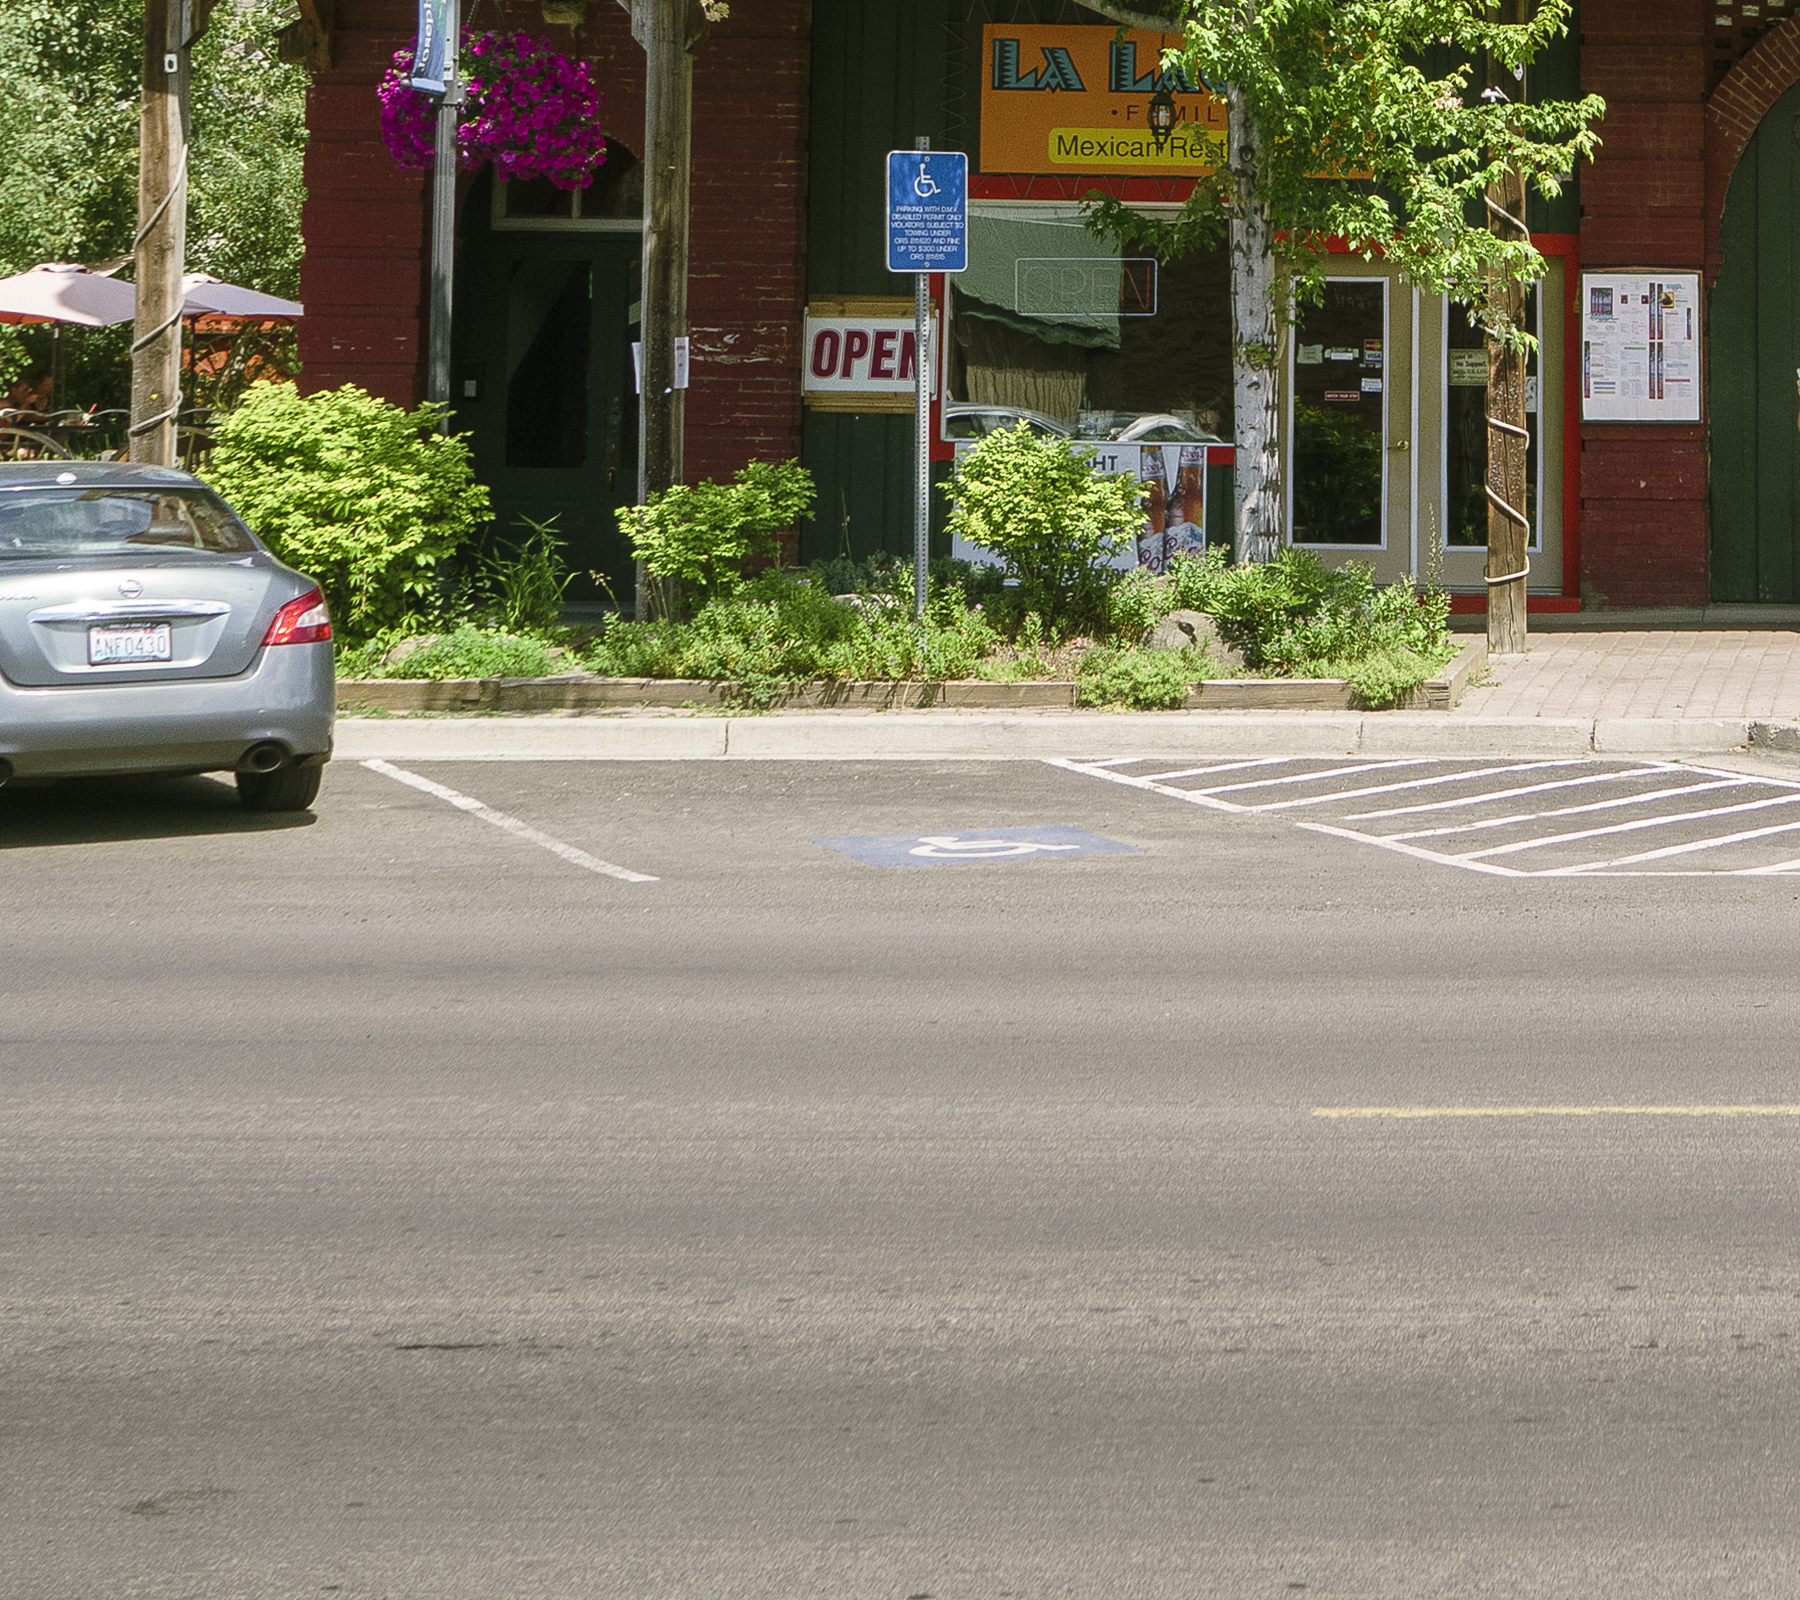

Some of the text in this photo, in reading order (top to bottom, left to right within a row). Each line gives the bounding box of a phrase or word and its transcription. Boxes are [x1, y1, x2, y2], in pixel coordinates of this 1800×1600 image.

[992, 38, 1088, 94] LA
[1056, 134, 1160, 157] Mexican
[946, 213, 963, 221] ONLY
[926, 221, 953, 229] SUBJECT
[904, 229, 952, 237] TOWING UNDER
[936, 245, 958, 253] UNDER
[1022, 266, 1151, 310] OPEN
